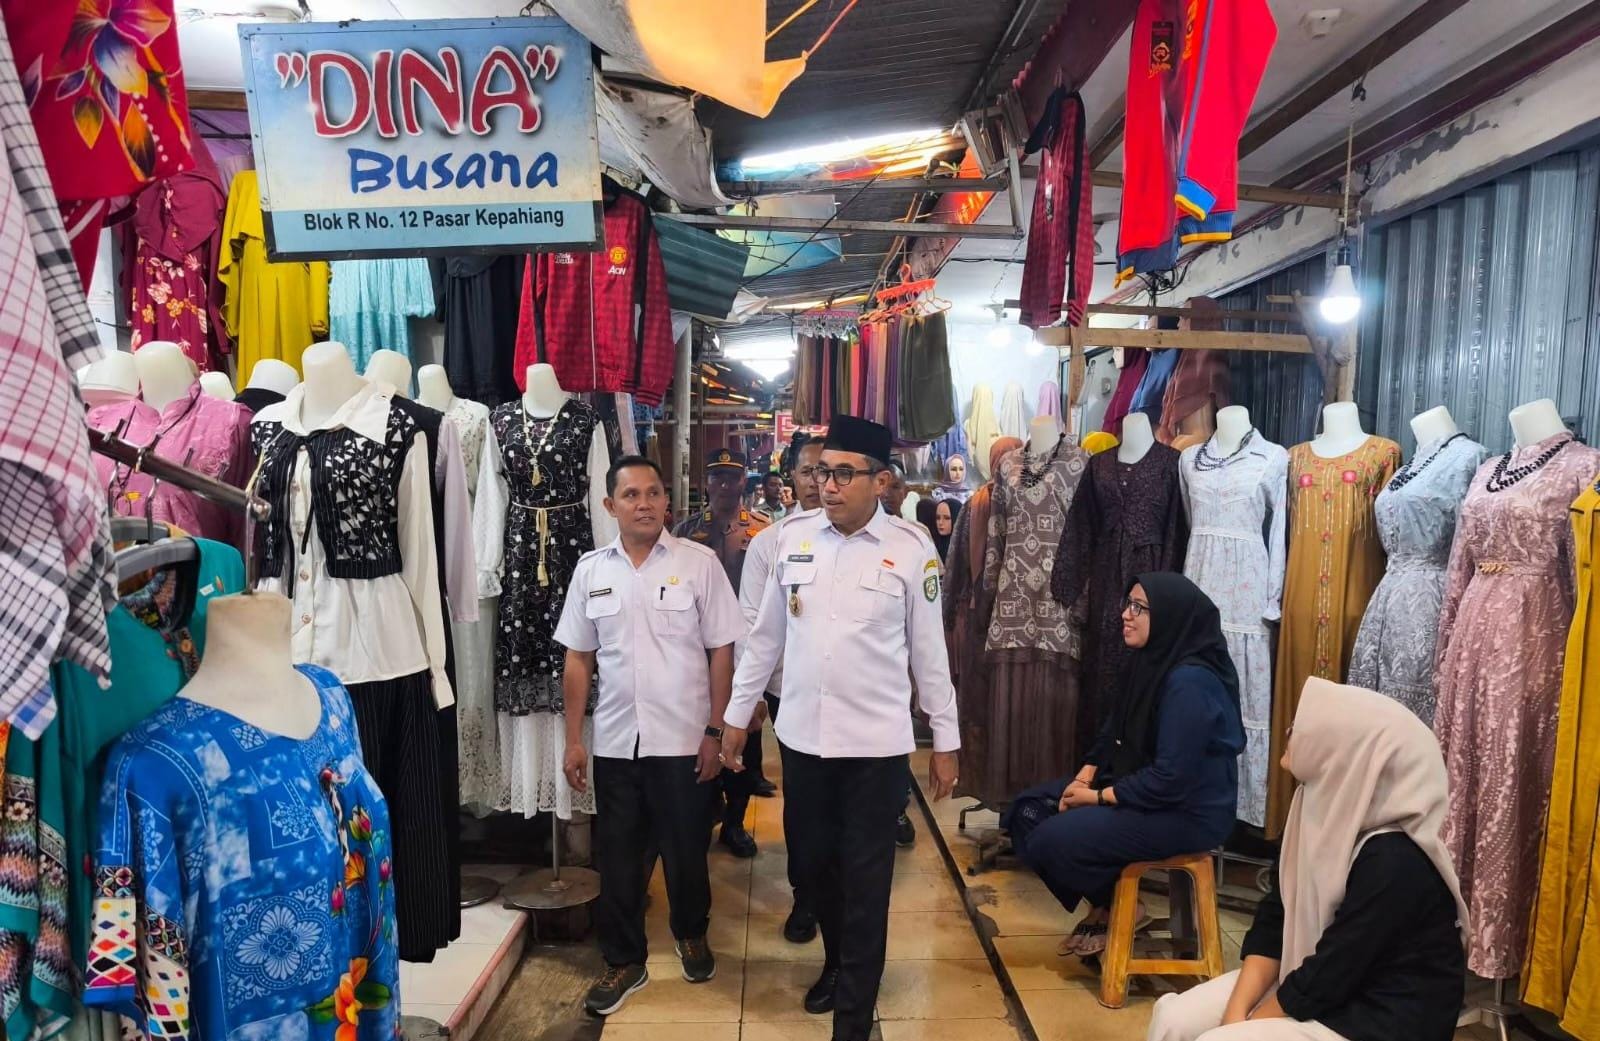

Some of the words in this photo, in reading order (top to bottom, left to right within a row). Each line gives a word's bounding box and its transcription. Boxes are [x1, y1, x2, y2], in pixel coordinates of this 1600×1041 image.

[347, 148, 560, 194] Busana
[304, 212, 343, 231] Blok
[347, 211, 361, 230] R
[365, 210, 395, 229] No.
[399, 209, 419, 228] 12
[423, 208, 471, 227] Pasar
[476, 206, 565, 229] Kepahiang
